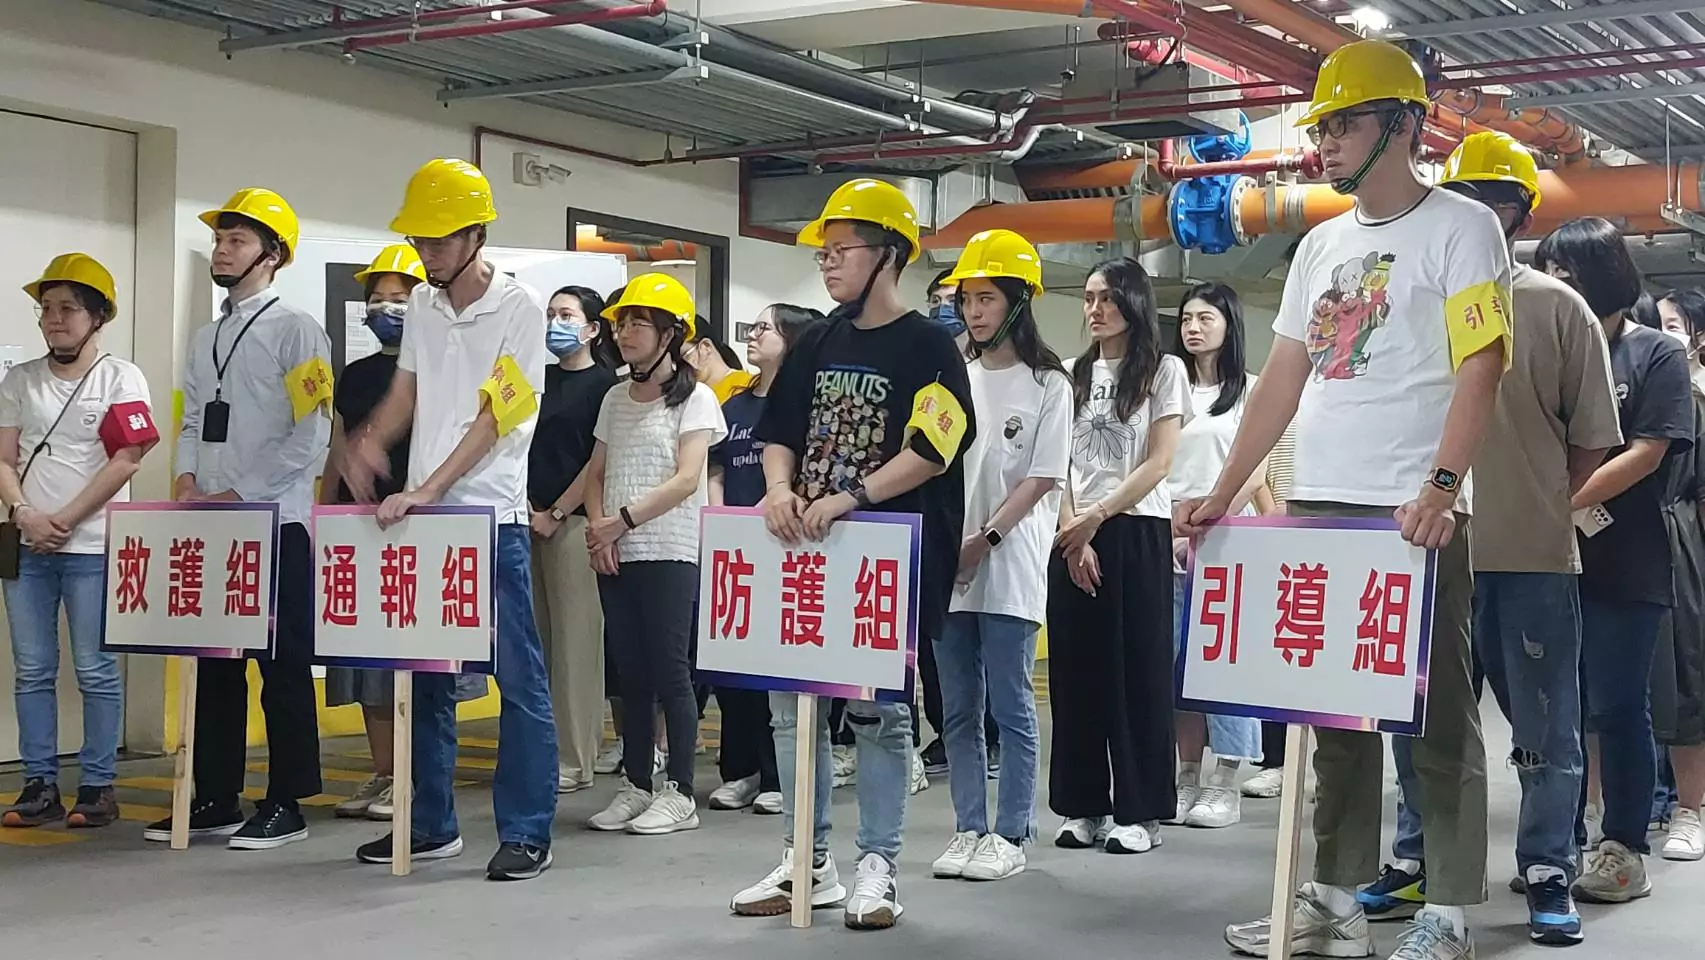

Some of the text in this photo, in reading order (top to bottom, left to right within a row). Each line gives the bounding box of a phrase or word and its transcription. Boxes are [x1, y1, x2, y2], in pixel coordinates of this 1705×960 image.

[814, 370, 889, 403] PEANUTS
[115, 536, 262, 618] 救護組
[321, 543, 482, 629] 通報組
[709, 548, 900, 651] 防護組
[1199, 561, 1413, 678] 引導組
